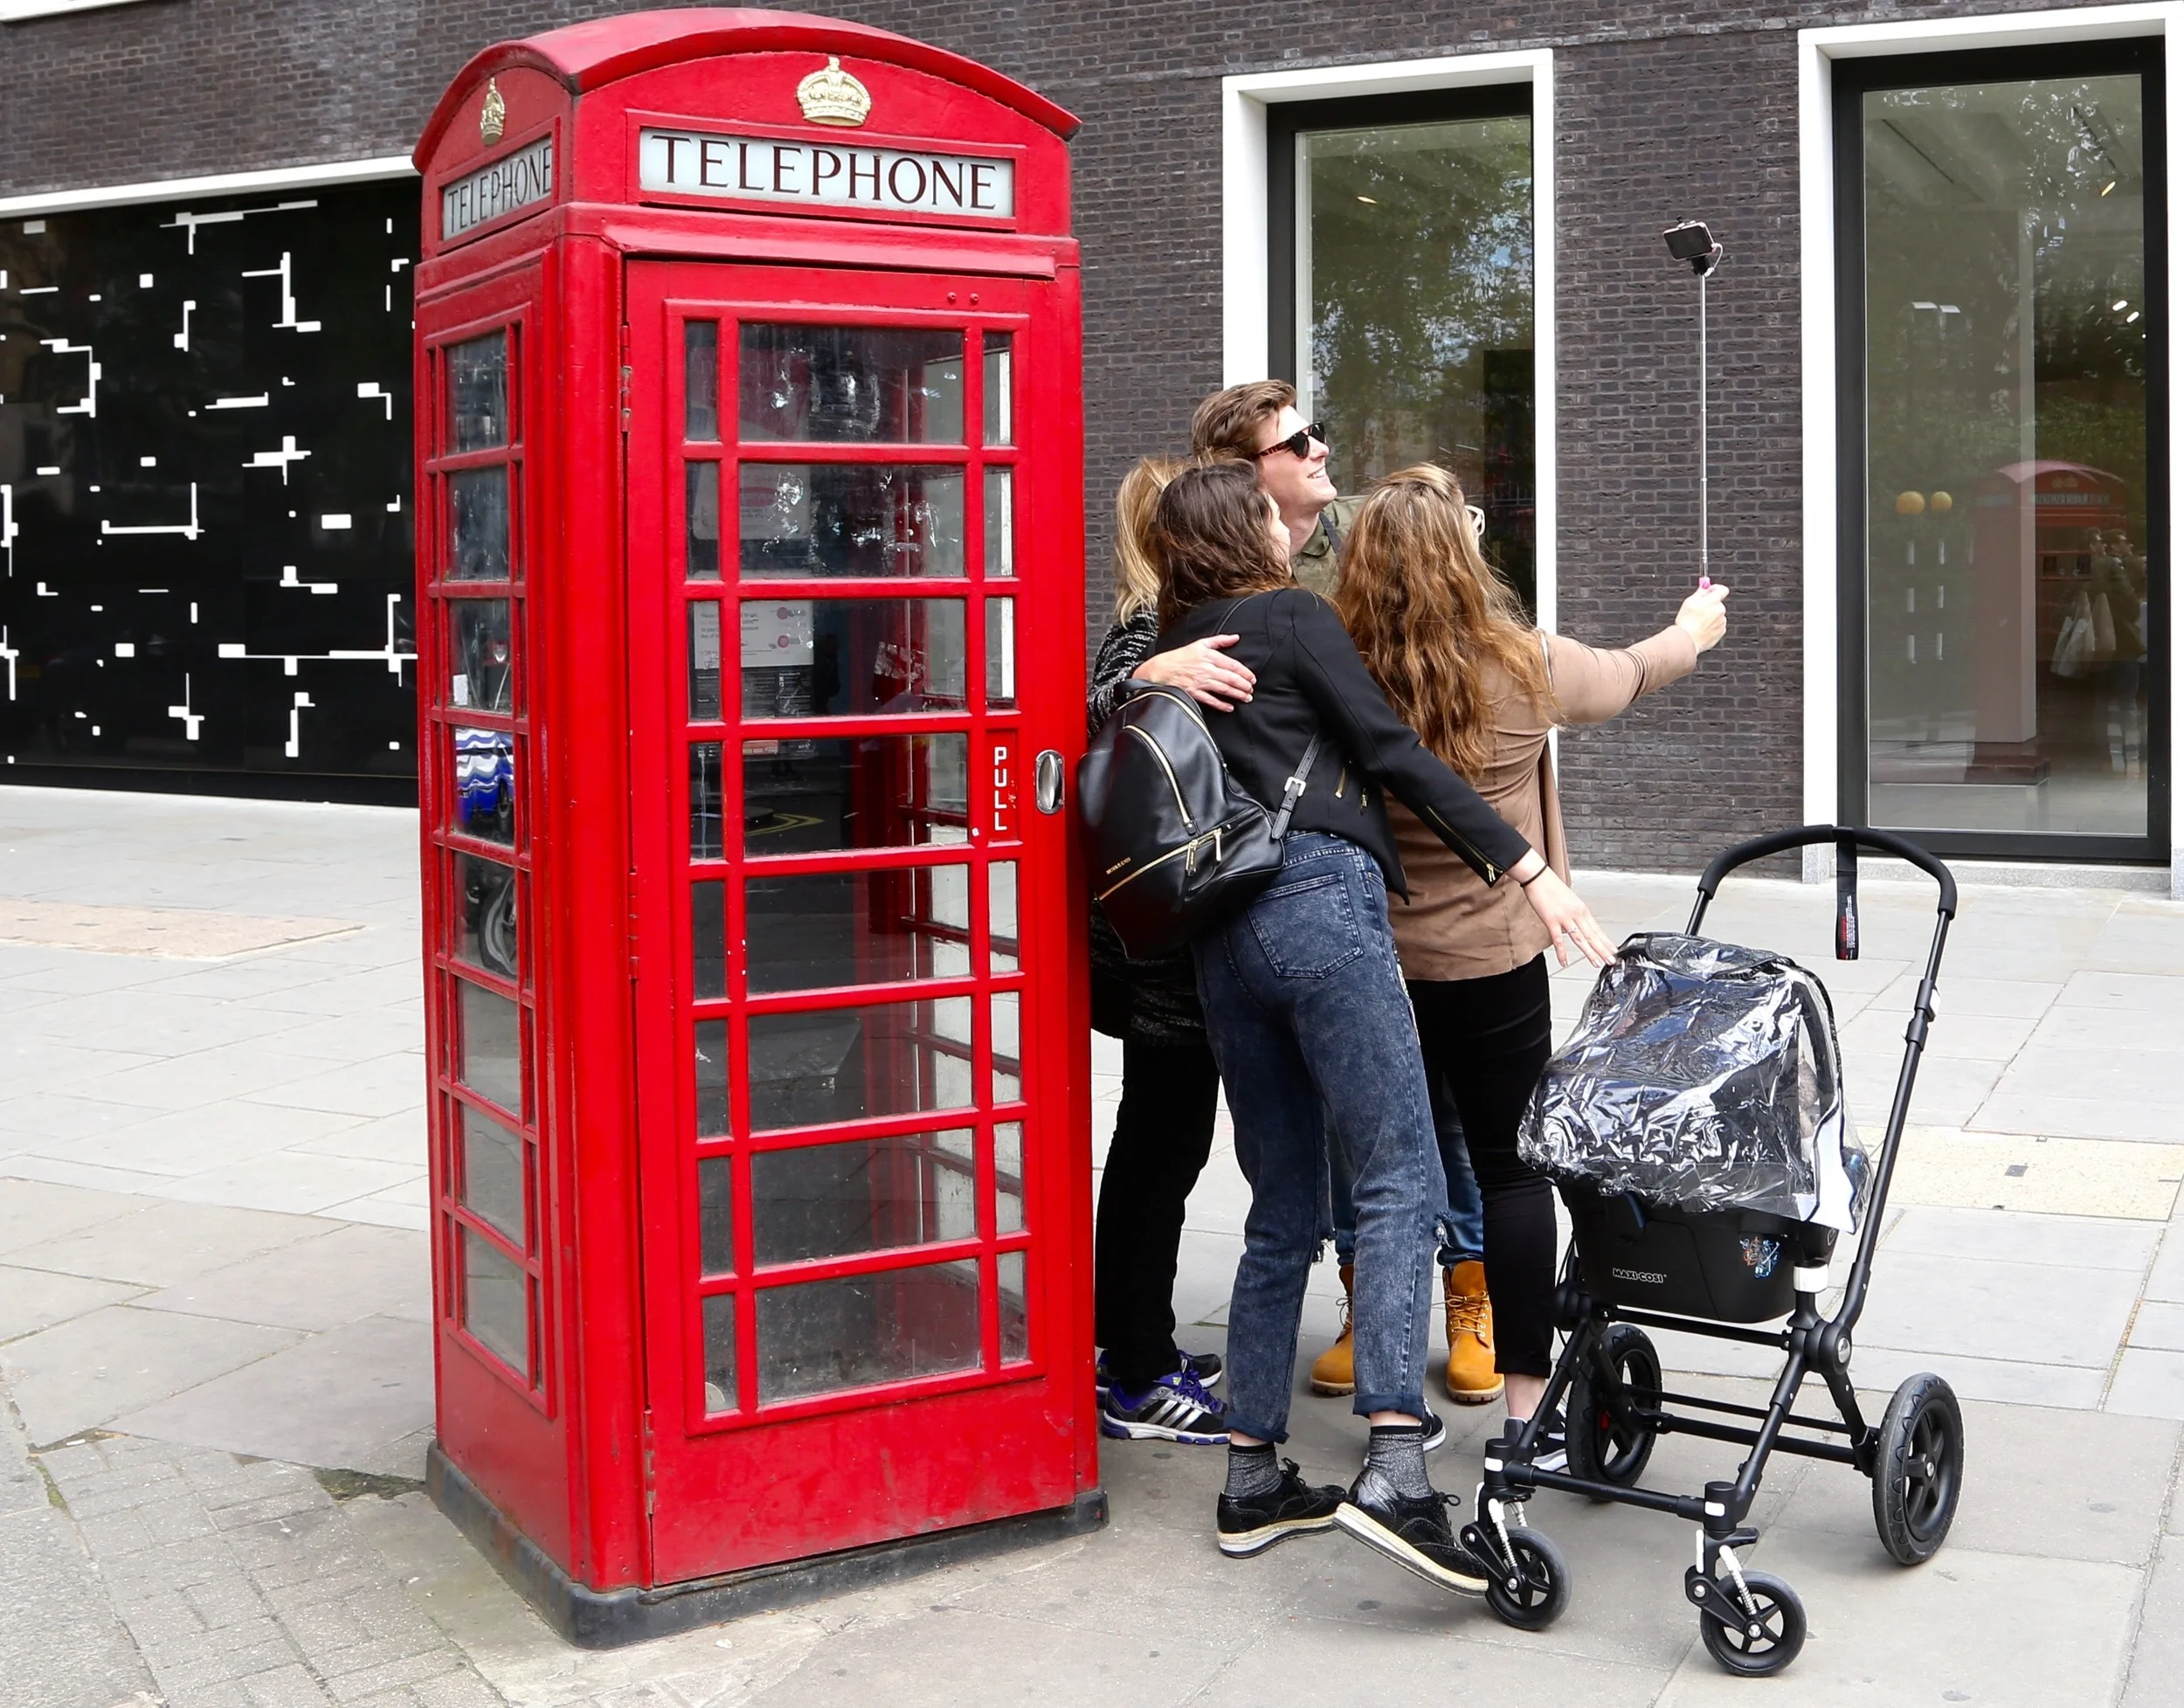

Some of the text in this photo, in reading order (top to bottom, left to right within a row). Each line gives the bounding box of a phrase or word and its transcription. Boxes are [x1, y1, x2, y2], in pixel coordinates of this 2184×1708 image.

[448, 145, 552, 233] TELEPHONE
[651, 135, 996, 210] TELEPHONE
[994, 746, 1007, 831] PULL
[1612, 1268, 1664, 1283] MAXI-COSI
